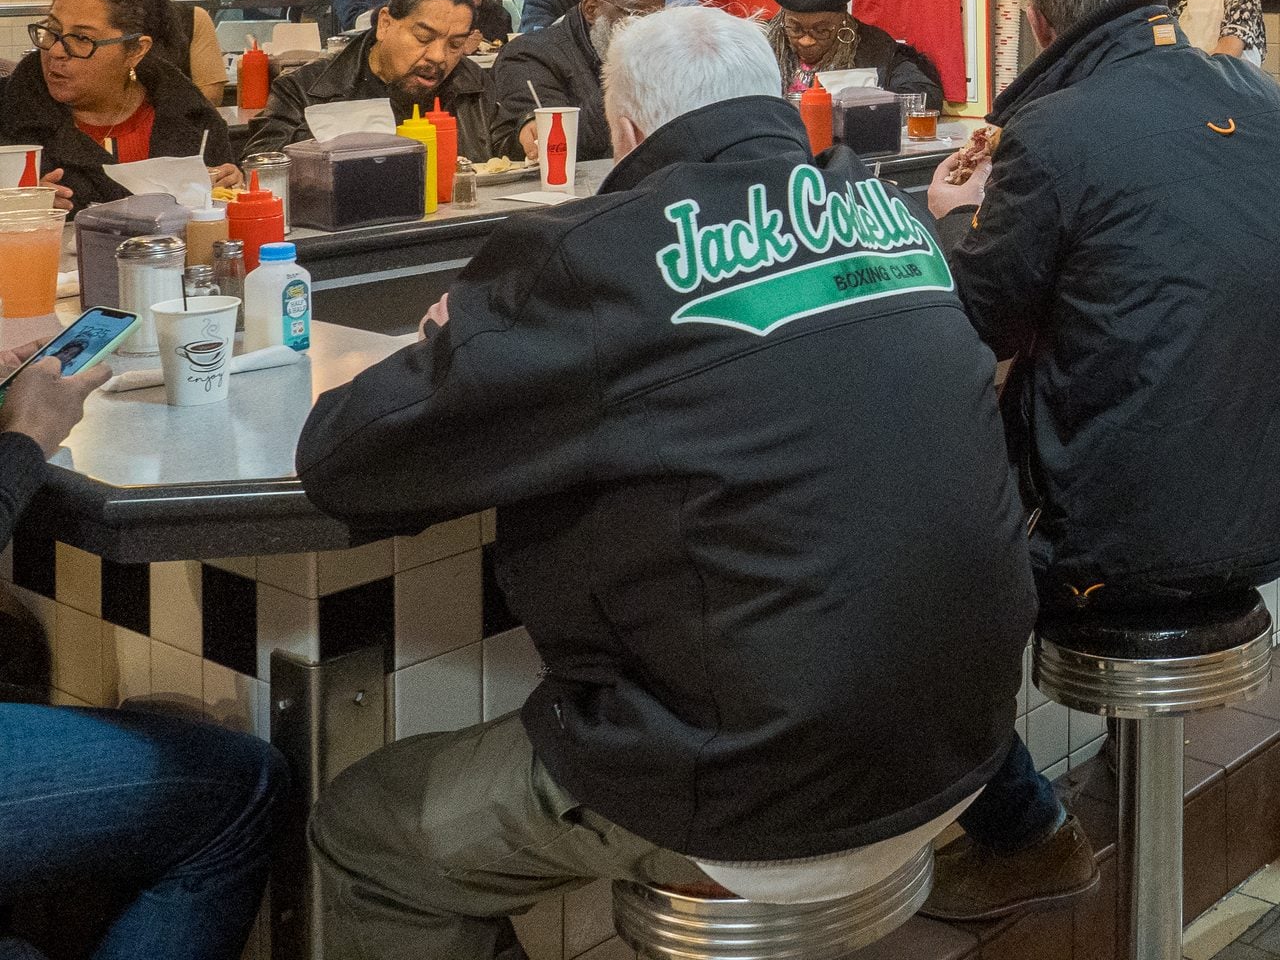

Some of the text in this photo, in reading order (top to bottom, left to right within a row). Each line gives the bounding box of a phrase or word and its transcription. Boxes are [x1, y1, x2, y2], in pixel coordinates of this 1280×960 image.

[656, 183, 798, 293] Jack
[834, 262, 923, 292] BOXING CLUB
[187, 369, 227, 392] enjoy
